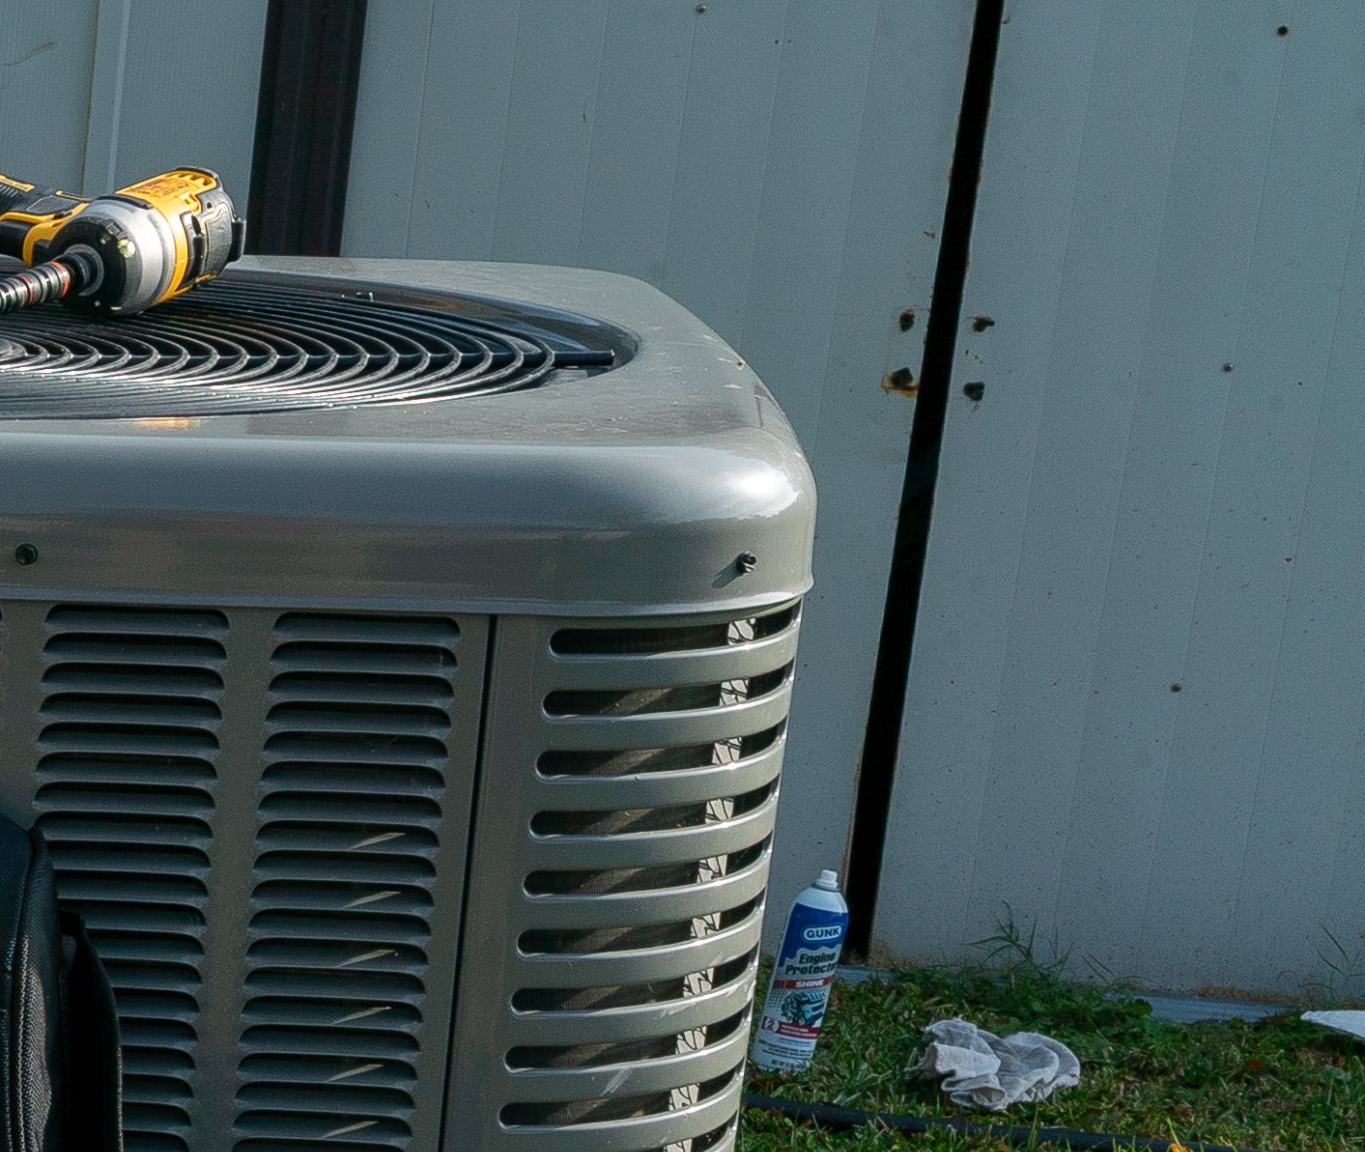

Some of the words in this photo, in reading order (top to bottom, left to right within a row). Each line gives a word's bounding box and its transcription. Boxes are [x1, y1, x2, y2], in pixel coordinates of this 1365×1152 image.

[806, 927, 840, 938] GUNK
[799, 952, 836, 965] Engine
[796, 980, 824, 988] SHINE
